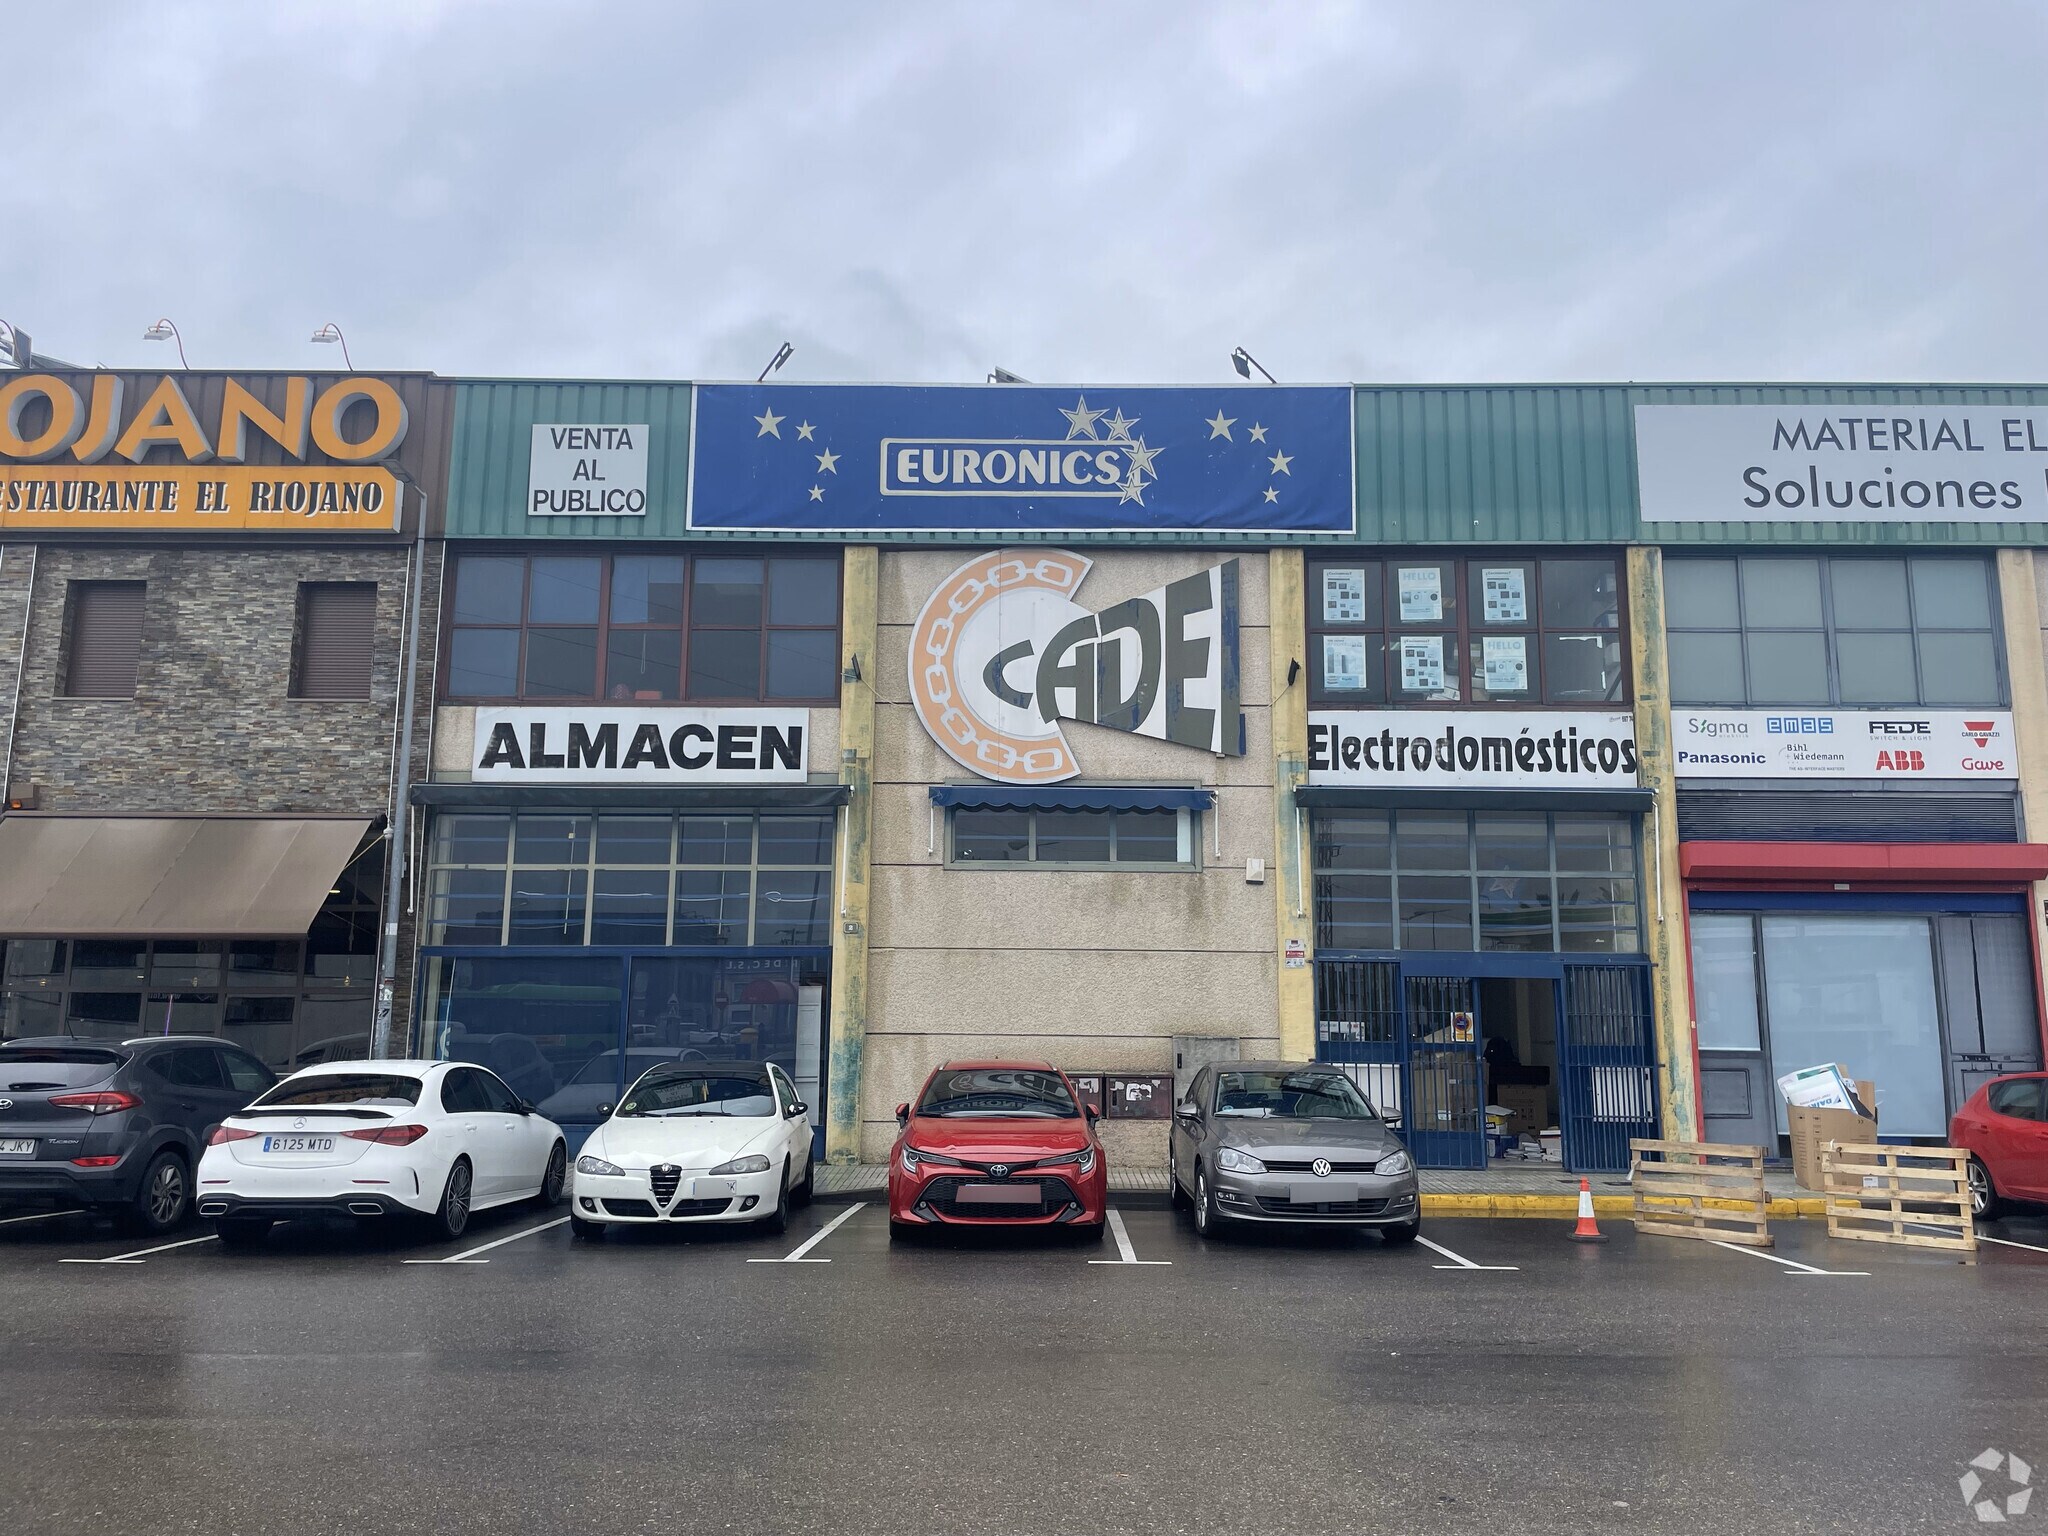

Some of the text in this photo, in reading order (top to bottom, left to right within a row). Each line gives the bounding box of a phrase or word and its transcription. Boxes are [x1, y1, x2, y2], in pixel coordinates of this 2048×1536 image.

[0, 374, 407, 463] OJANO
[550, 427, 634, 450] VENTA
[1773, 418, 1984, 451] MATERIAL
[572, 459, 606, 481] AL
[897, 449, 1121, 485] EURONICS
[1743, 465, 2021, 509] Soluciones
[195, 480, 231, 513] EL
[249, 480, 383, 518] RIOJANO
[533, 488, 645, 513] PUBLICO
[1403, 572, 1437, 581] HELLO
[1488, 641, 1521, 650] HELLO
[1767, 718, 1834, 733] emas
[1869, 721, 1931, 734] FEDE
[478, 722, 803, 771] ALMACEN
[1308, 725, 1637, 774] Electrodomésticos
[1787, 744, 1808, 752] Bihl
[1793, 752, 1845, 761] Wiedemann
[1678, 751, 1766, 764] Panasonic
[1876, 751, 1925, 771] ABB
[9, 1141, 33, 1152] JKY
[273, 1138, 332, 1150] 6125 MTD
